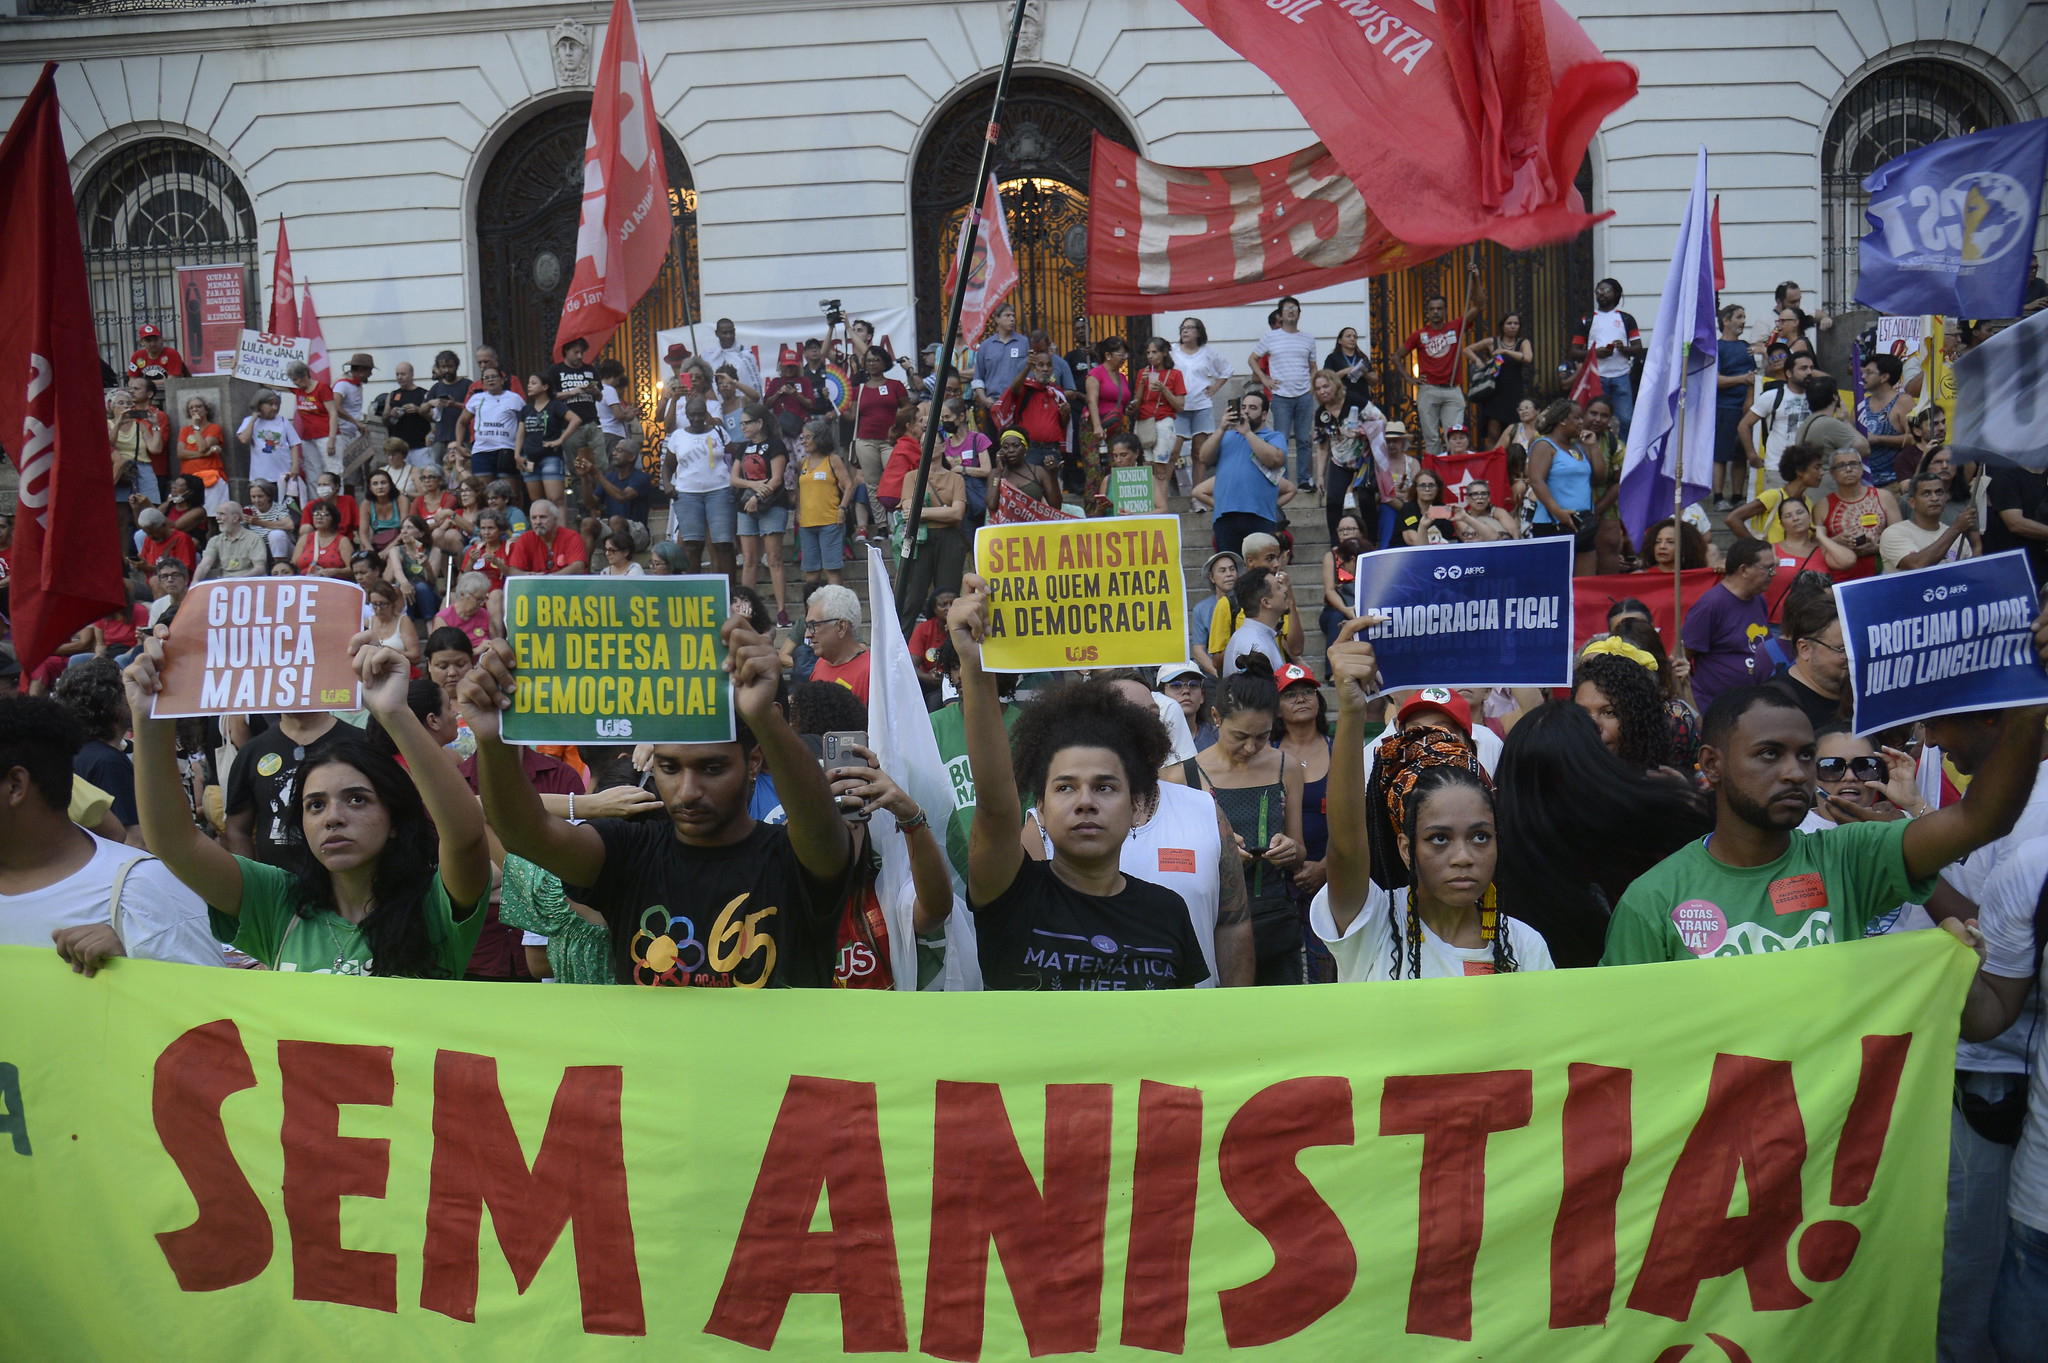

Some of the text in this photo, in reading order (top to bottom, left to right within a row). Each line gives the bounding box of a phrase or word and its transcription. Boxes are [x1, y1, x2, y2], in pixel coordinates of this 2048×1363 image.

[206, 287, 241, 298] PARA NÃO
[207, 280, 240, 289] MEMÓRIA
[206, 296, 241, 305] ESQUECER
[219, 304, 242, 312] NOSSA
[207, 312, 242, 321] HISTÓRIA
[256, 332, 296, 348] SOS
[241, 340, 305, 361] LULA e JANJA
[236, 363, 251, 376] PÃO
[252, 366, 262, 377] DE
[242, 354, 280, 368] SALVEM
[560, 372, 584, 382] Lute
[561, 380, 590, 389] como
[1116, 469, 1148, 483] NENHUM
[1118, 484, 1148, 499] DIREITO
[1124, 499, 1152, 513] MENOS!
[988, 529, 1169, 574] SEM ANISTIA
[989, 569, 1170, 603] PARA QUEM ATACA
[207, 584, 319, 628] GOLPE
[515, 595, 717, 628] O BRASIL SE UNE
[991, 600, 1172, 638] A DEMOCRACIA
[1367, 595, 1559, 641] DEMOCRACIA FICA!
[1866, 595, 2032, 659] PROTEJAM O PADRE
[205, 624, 316, 669] NUNCA
[514, 632, 717, 671] EM DEFESA DA
[1864, 632, 2033, 698] JULIO LANCELLOTTI
[200, 666, 314, 709] MAIS!
[514, 675, 717, 716] DEMOCRACIA!
[1776, 894, 1799, 905] CESSAR
[1679, 908, 1713, 919] COTAS
[1679, 919, 1719, 931] TRANS
[707, 892, 778, 989] 65
[1683, 930, 1708, 949] JÁ!
[1023, 946, 1177, 979] MATEMÁTICA
[152, 1018, 646, 1336] SEM
[703, 1034, 1912, 1363] ANISTIA!
